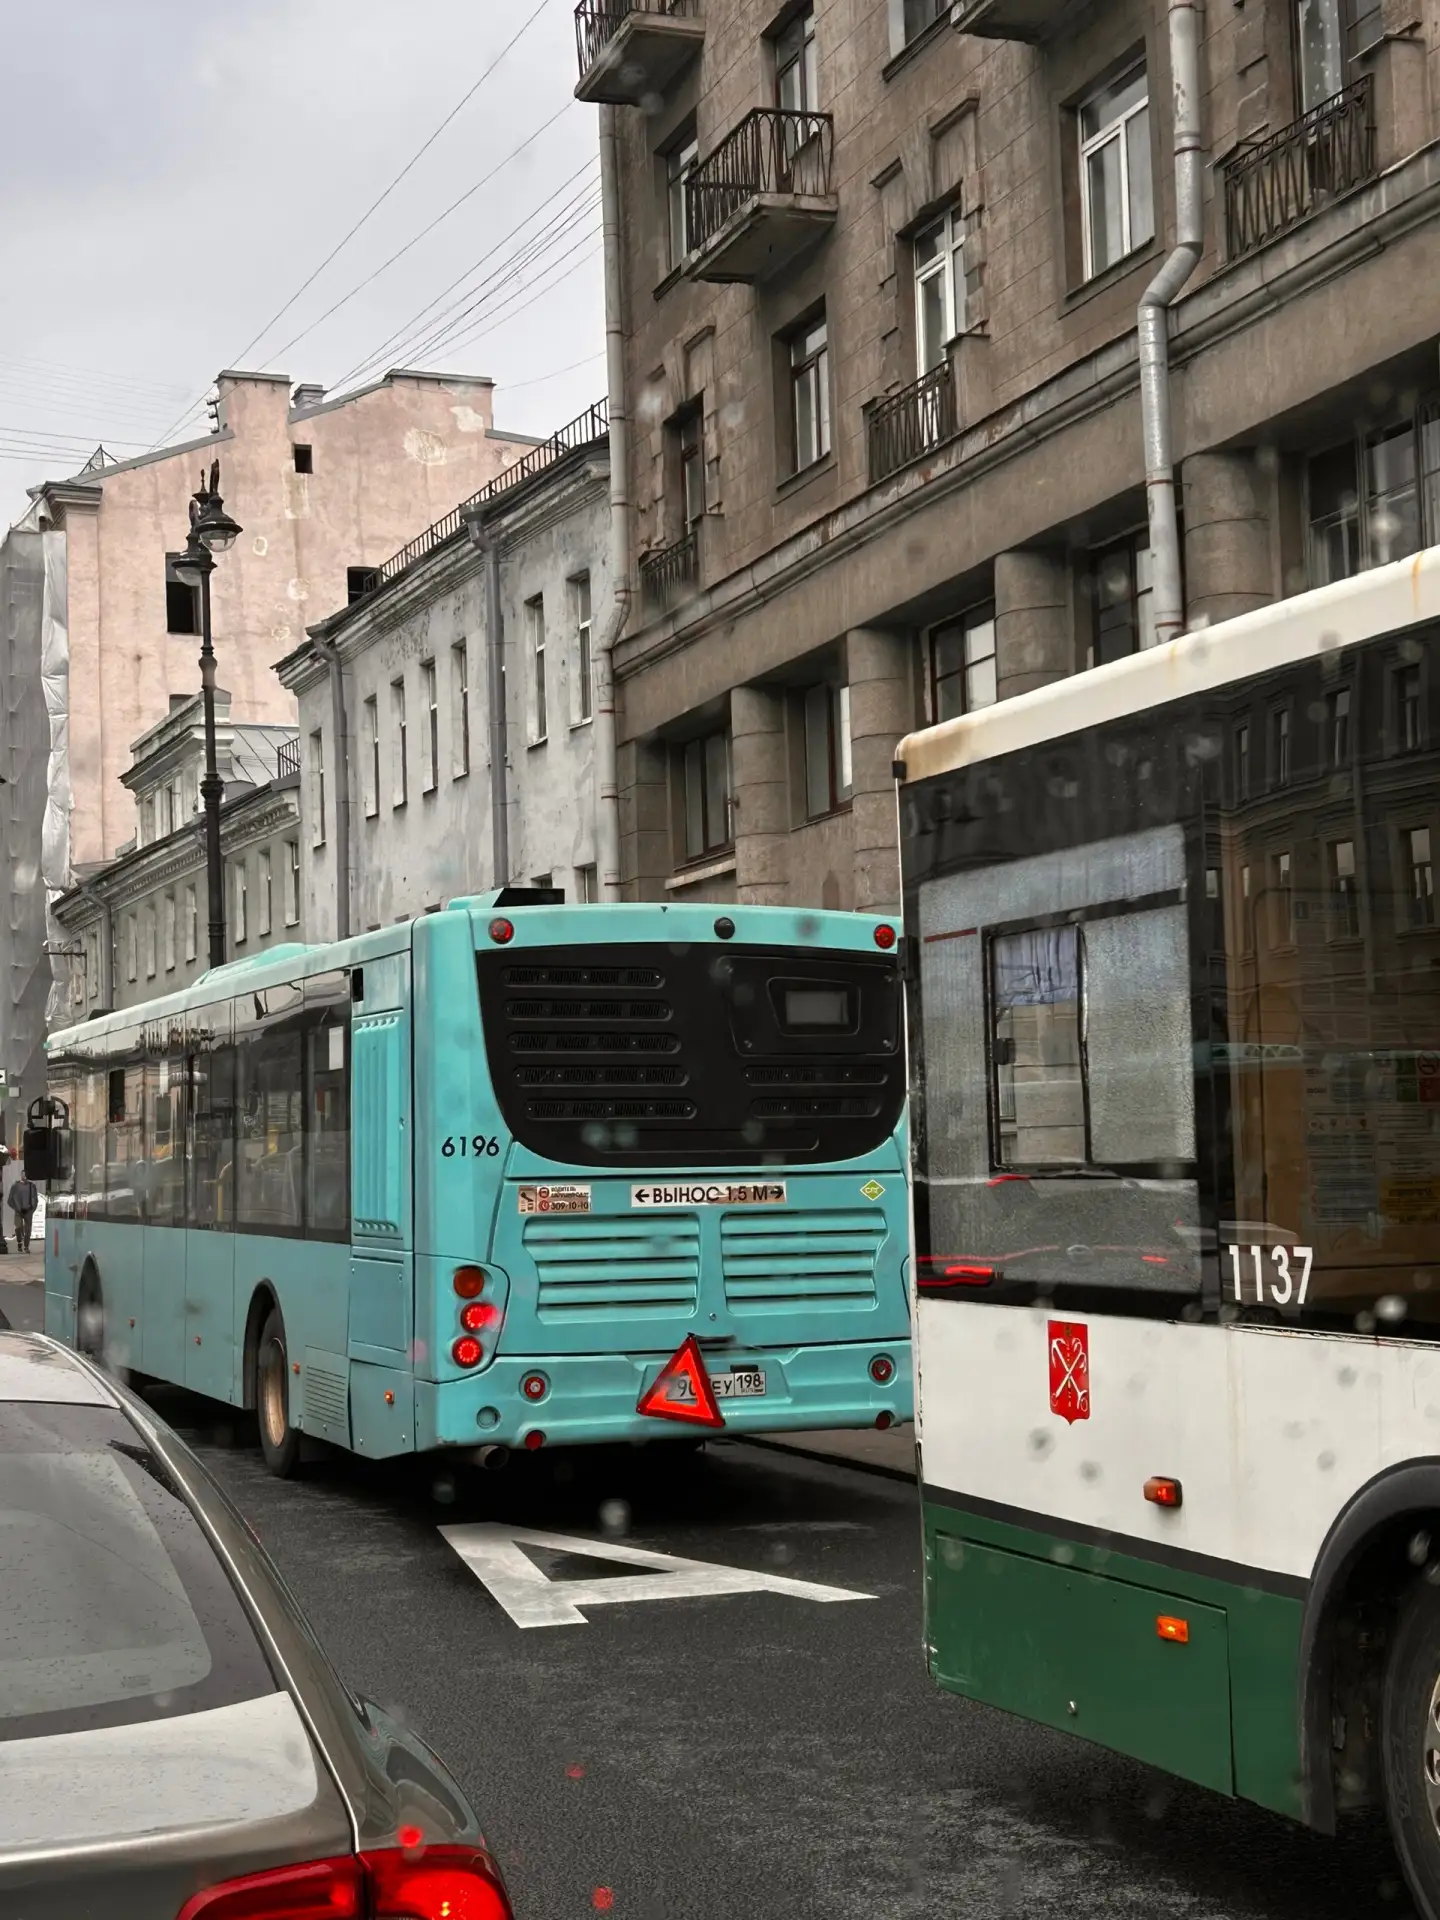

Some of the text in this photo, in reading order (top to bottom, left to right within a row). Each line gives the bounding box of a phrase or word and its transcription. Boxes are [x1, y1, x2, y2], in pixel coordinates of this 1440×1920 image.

[441, 1135, 499, 1157] 6196
[653, 1186, 720, 1203] ВЫНОС
[752, 1185, 768, 1200] М
[1228, 1244, 1313, 1305] 1137
[736, 1373, 761, 1389] 198
